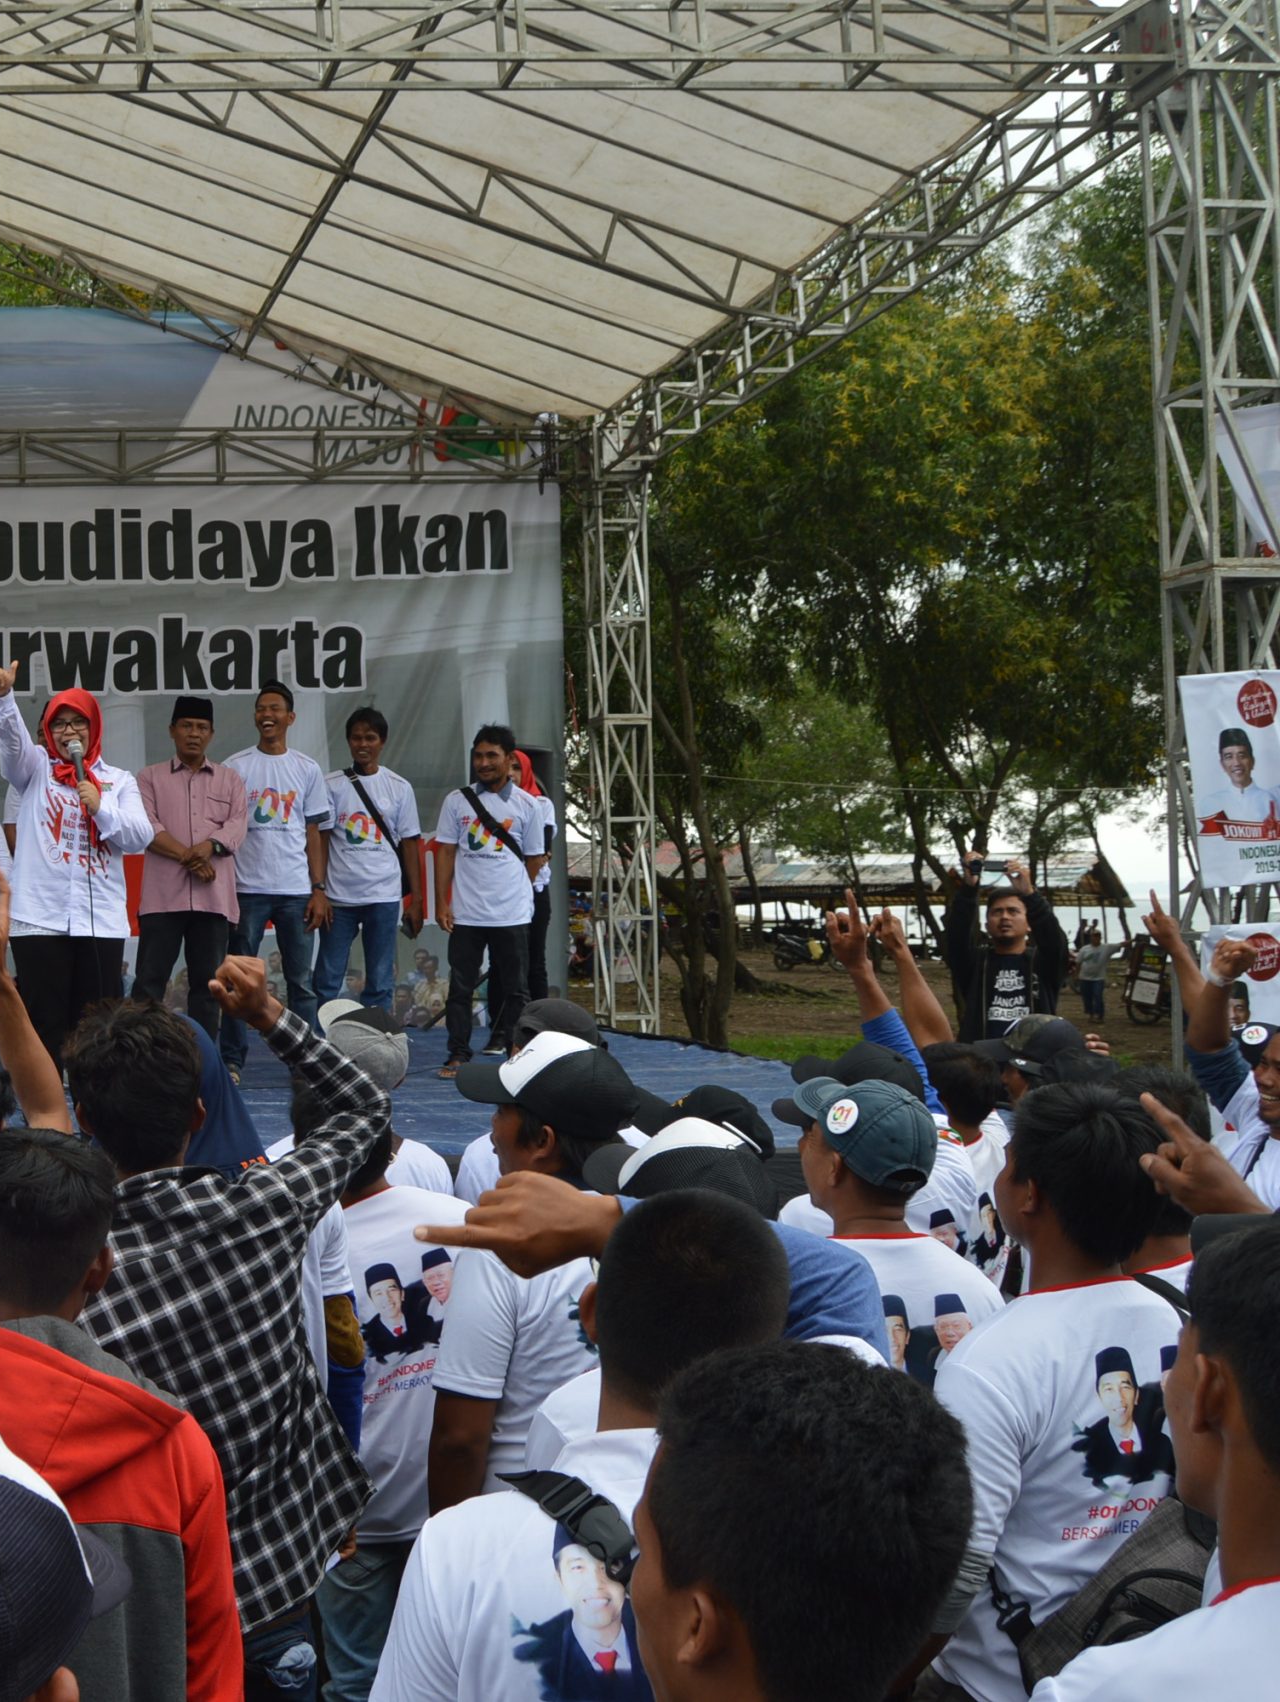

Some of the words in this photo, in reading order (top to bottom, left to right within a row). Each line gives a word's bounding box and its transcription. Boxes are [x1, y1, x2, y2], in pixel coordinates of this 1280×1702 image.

[233, 404, 406, 429] INDONESIA
[353, 503, 509, 576] Ikan
[248, 787, 297, 824] #01
[1223, 824, 1262, 838] JOKOWI
